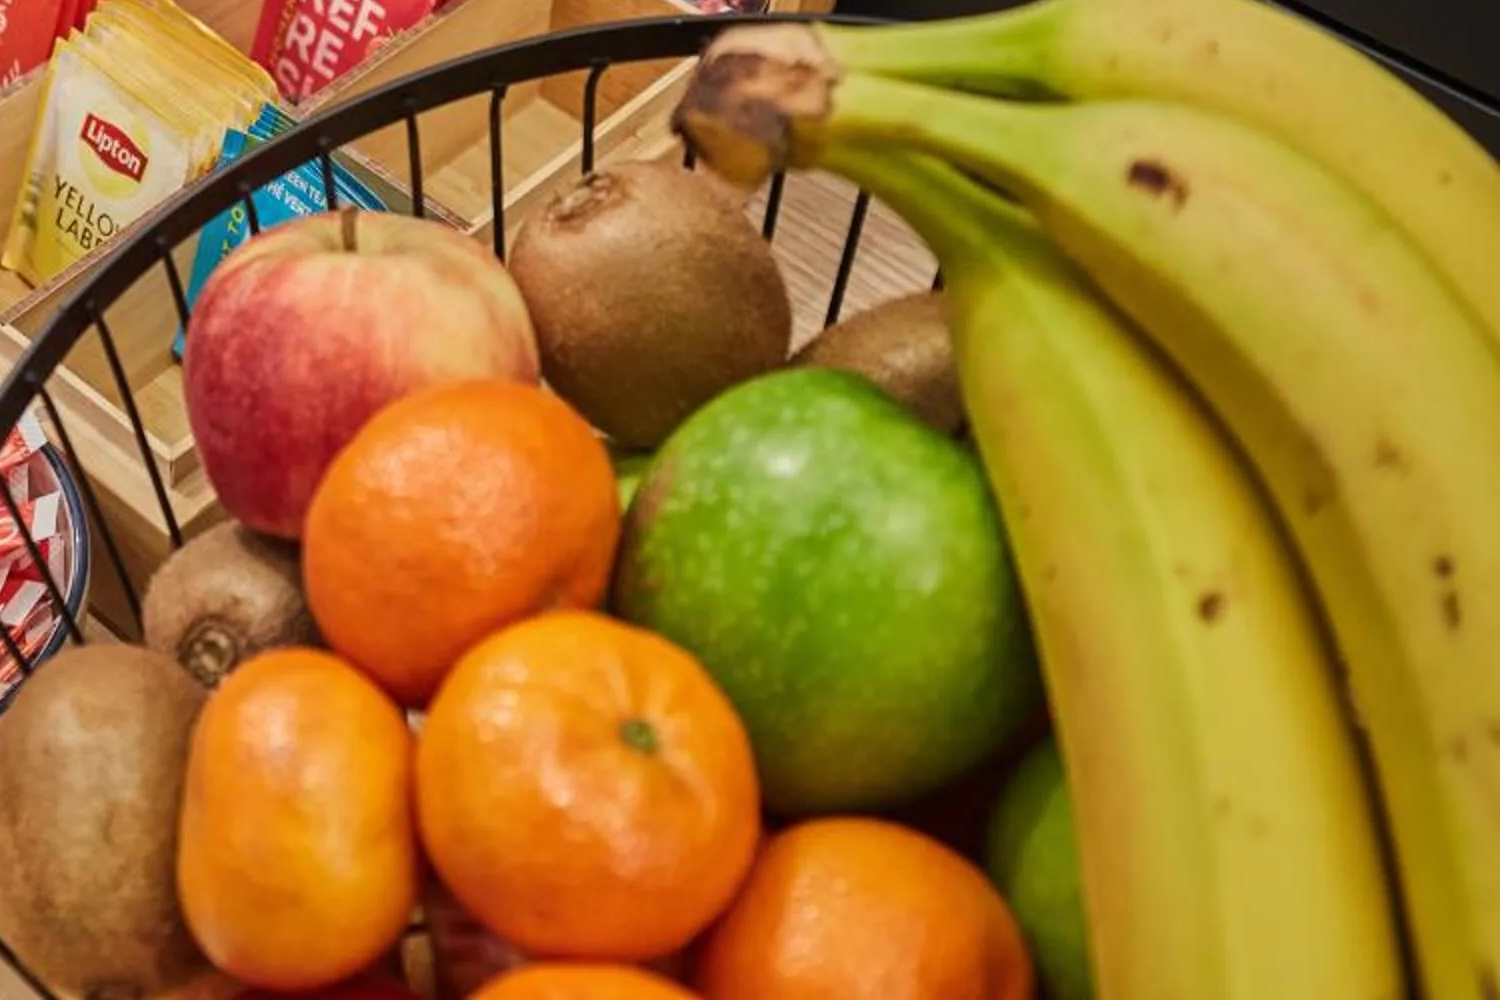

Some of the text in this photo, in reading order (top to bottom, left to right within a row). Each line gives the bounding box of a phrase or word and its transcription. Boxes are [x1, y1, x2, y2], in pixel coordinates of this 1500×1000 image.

[285, 13, 345, 80] RE
[86, 119, 142, 175] Lipton
[54, 174, 120, 237] YELLO
